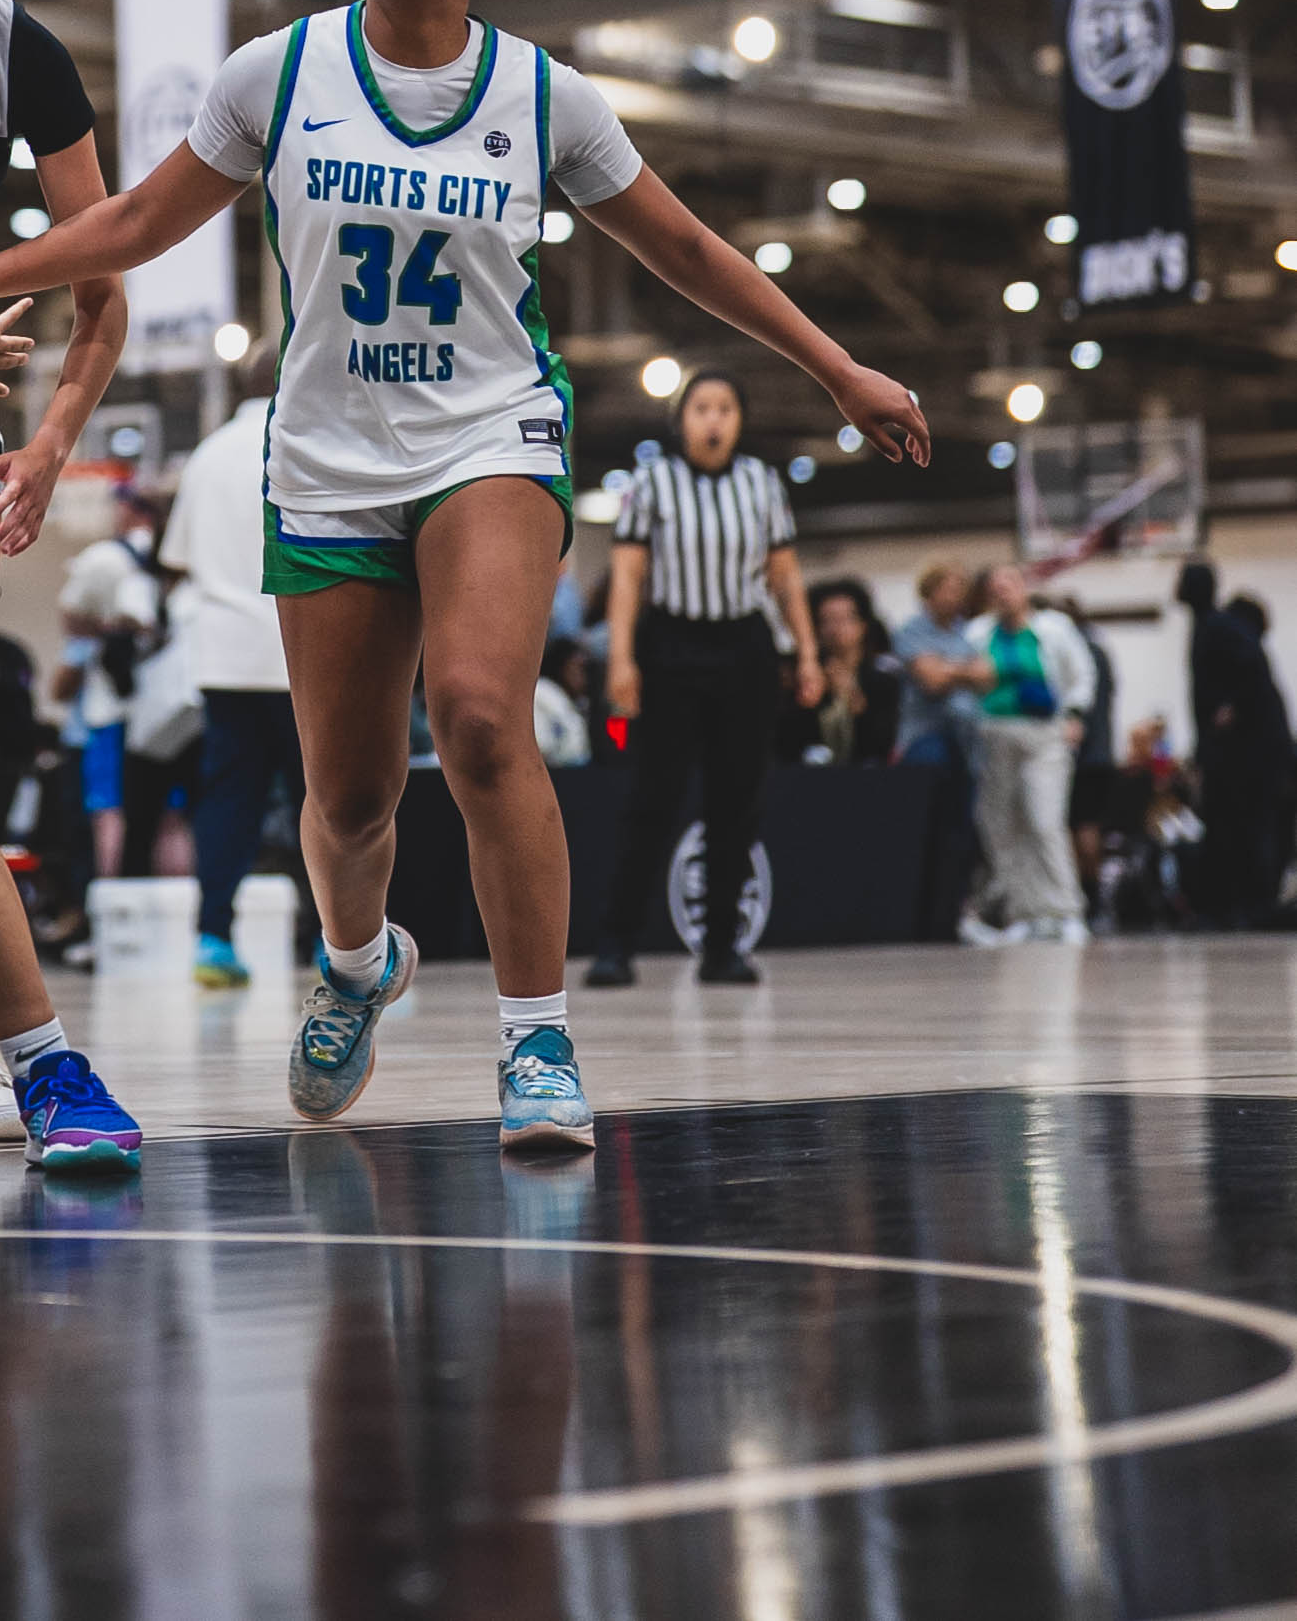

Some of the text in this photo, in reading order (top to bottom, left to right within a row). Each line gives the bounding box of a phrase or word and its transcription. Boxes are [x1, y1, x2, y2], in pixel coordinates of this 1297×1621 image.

[307, 158, 512, 222] SPORTS CITY
[338, 222, 463, 326] 34
[346, 338, 455, 383] ANGELS
